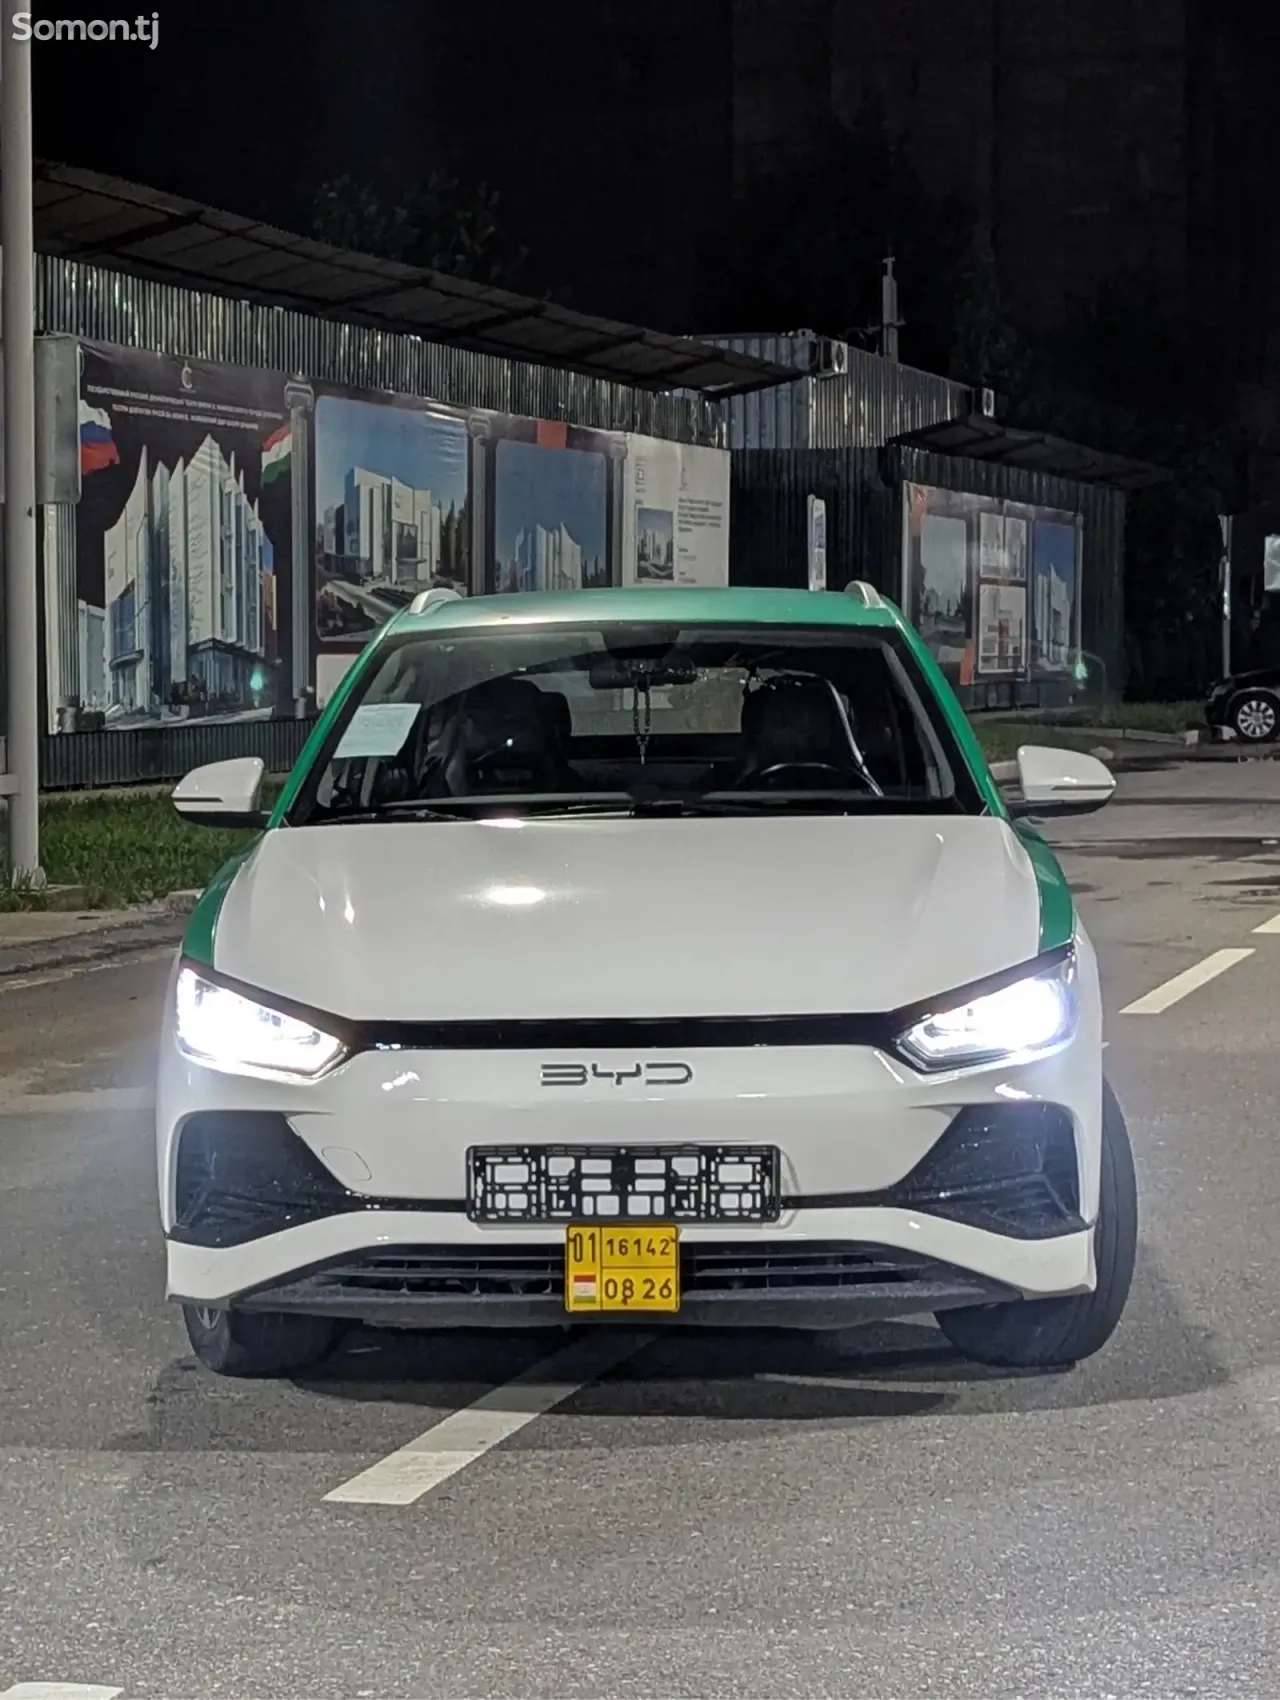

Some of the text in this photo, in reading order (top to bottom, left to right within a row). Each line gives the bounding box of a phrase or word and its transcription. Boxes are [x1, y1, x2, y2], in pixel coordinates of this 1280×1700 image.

[541, 1063, 693, 1086] BYD
[573, 1232, 670, 1263] 01 16142
